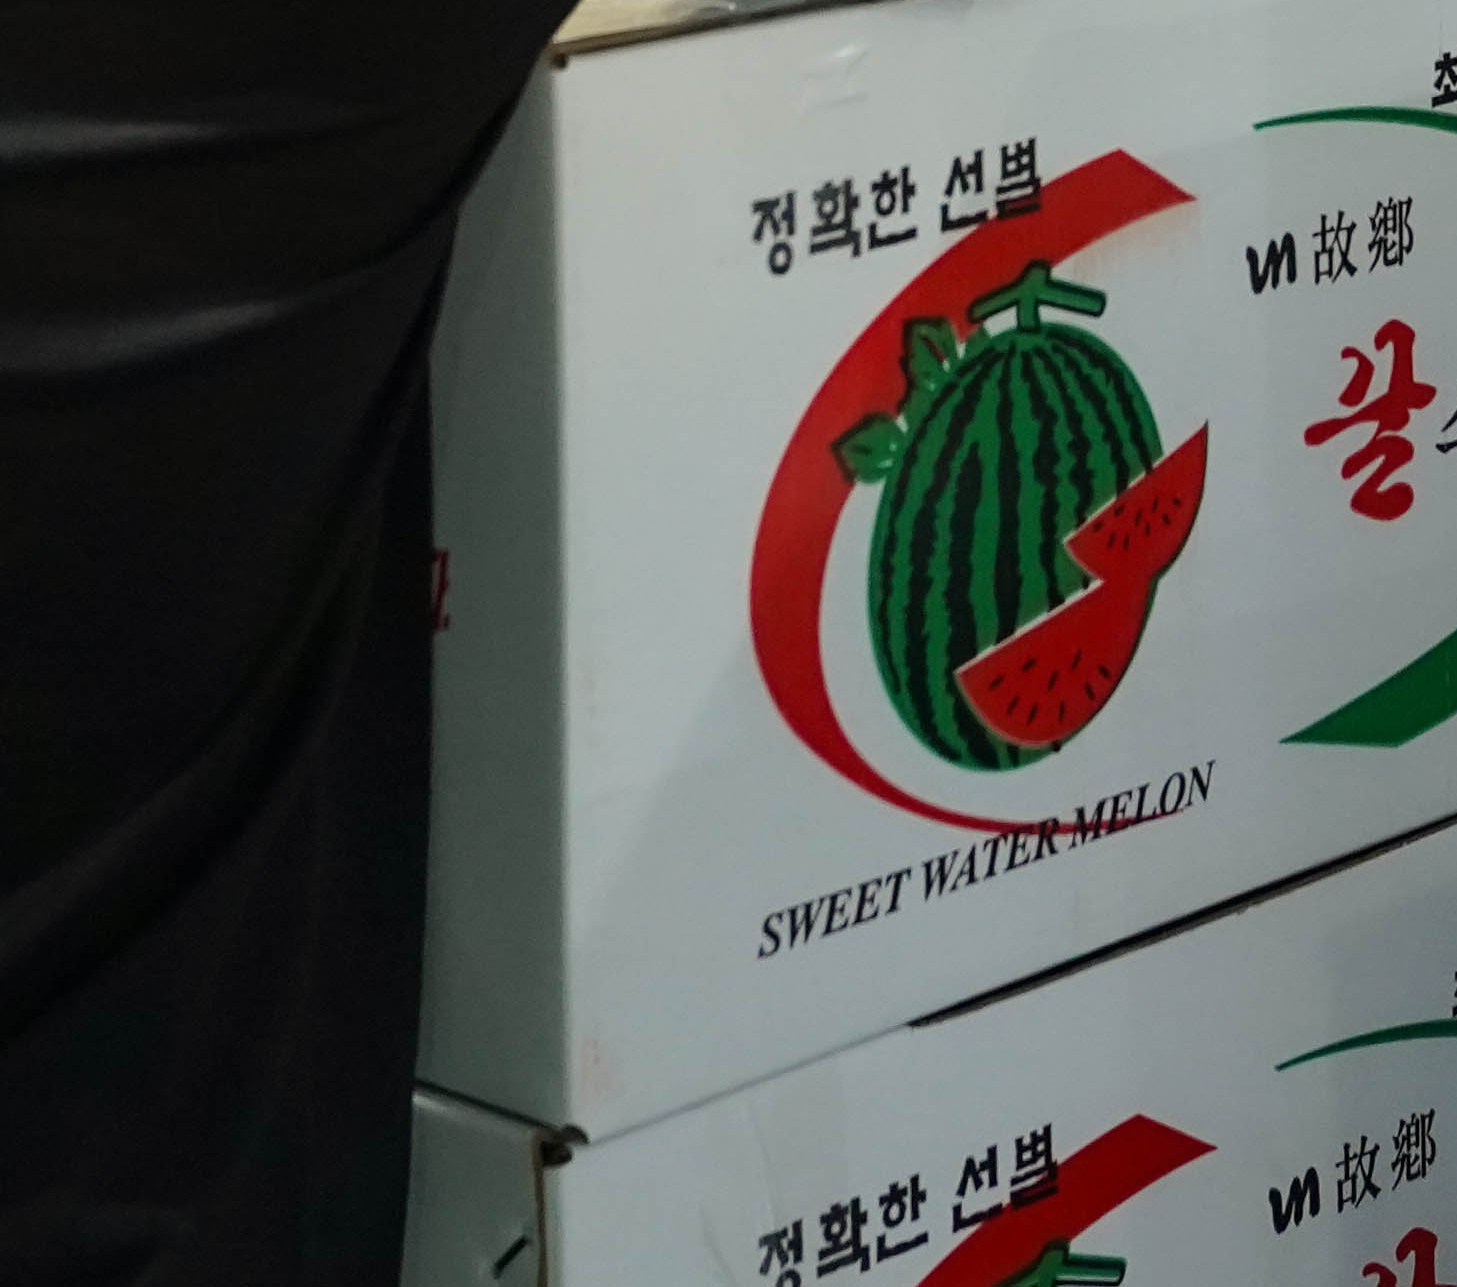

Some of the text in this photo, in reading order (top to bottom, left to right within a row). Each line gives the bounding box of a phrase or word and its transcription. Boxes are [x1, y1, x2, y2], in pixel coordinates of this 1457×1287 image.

[751, 136, 1042, 276] 정확한 선별
[757, 760, 1215, 960] SWEET WATER MELON
[952, 1124, 1060, 1233] 선별
